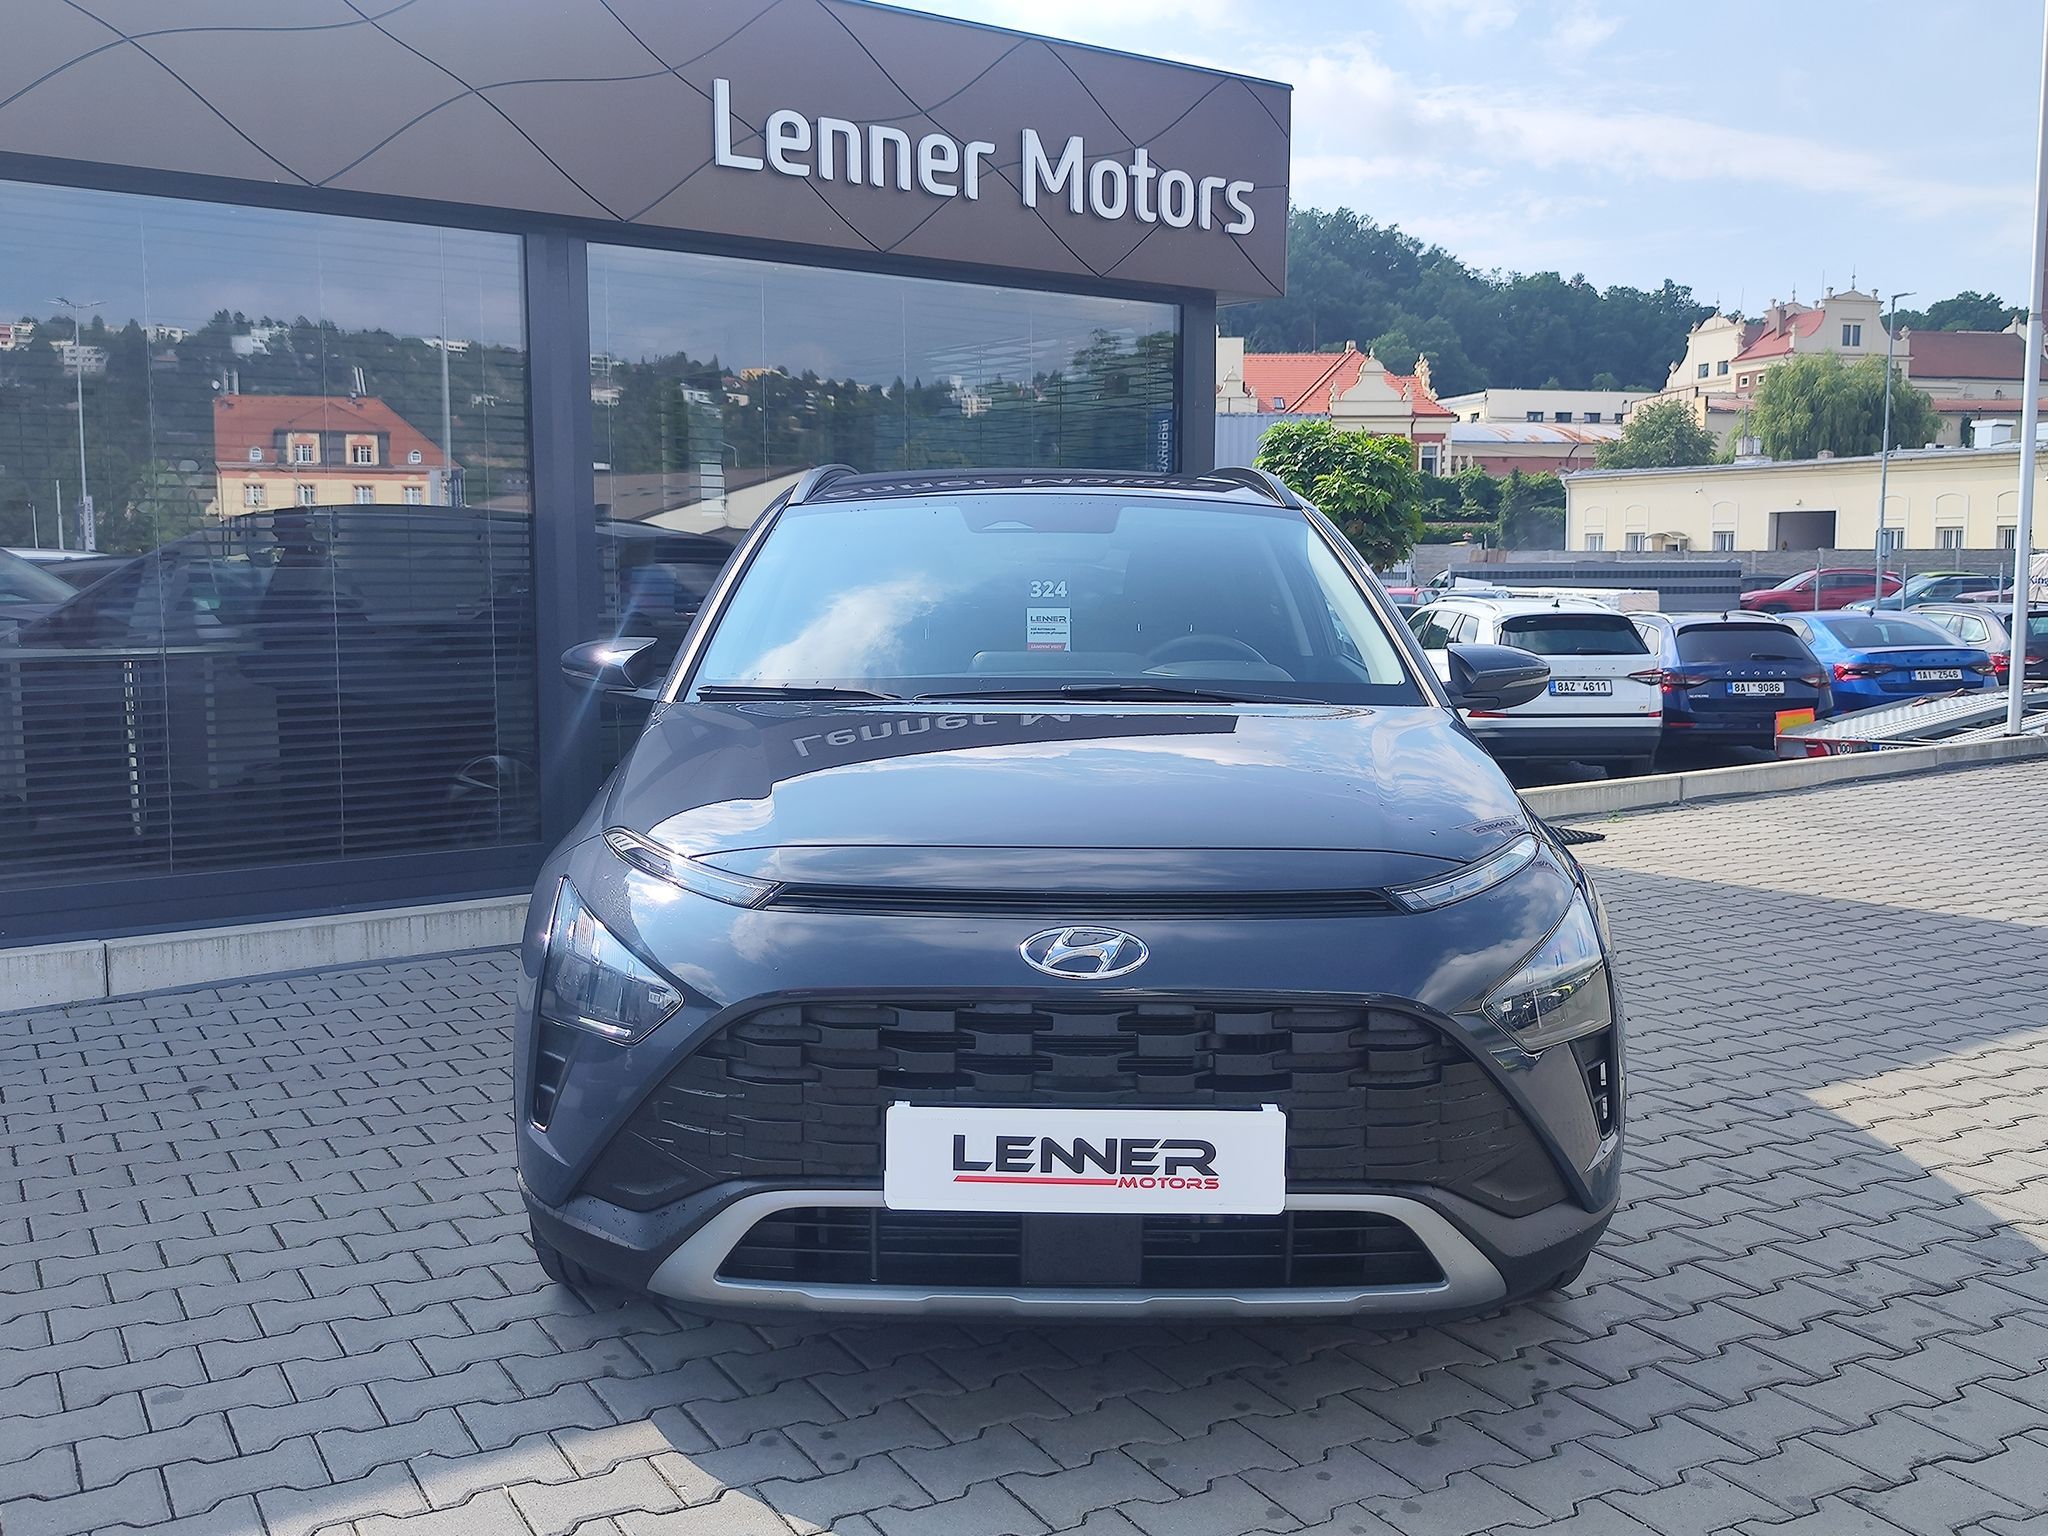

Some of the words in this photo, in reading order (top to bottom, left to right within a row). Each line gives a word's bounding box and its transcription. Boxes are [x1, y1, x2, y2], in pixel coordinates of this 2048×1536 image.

[712, 77, 996, 200] Lenner
[1020, 127, 1256, 236] Motors
[1030, 580, 1068, 598] 324
[1030, 615, 1067, 623] LENNER
[1917, 670, 1932, 680] 1AI
[1557, 681, 1576, 692] 8AZ
[1583, 681, 1607, 692] 4611
[1734, 683, 1750, 692] 8AI
[1759, 683, 1780, 692] 9086
[952, 1133, 1219, 1176] LENNER
[1117, 1176, 1219, 1190] MOTORS
